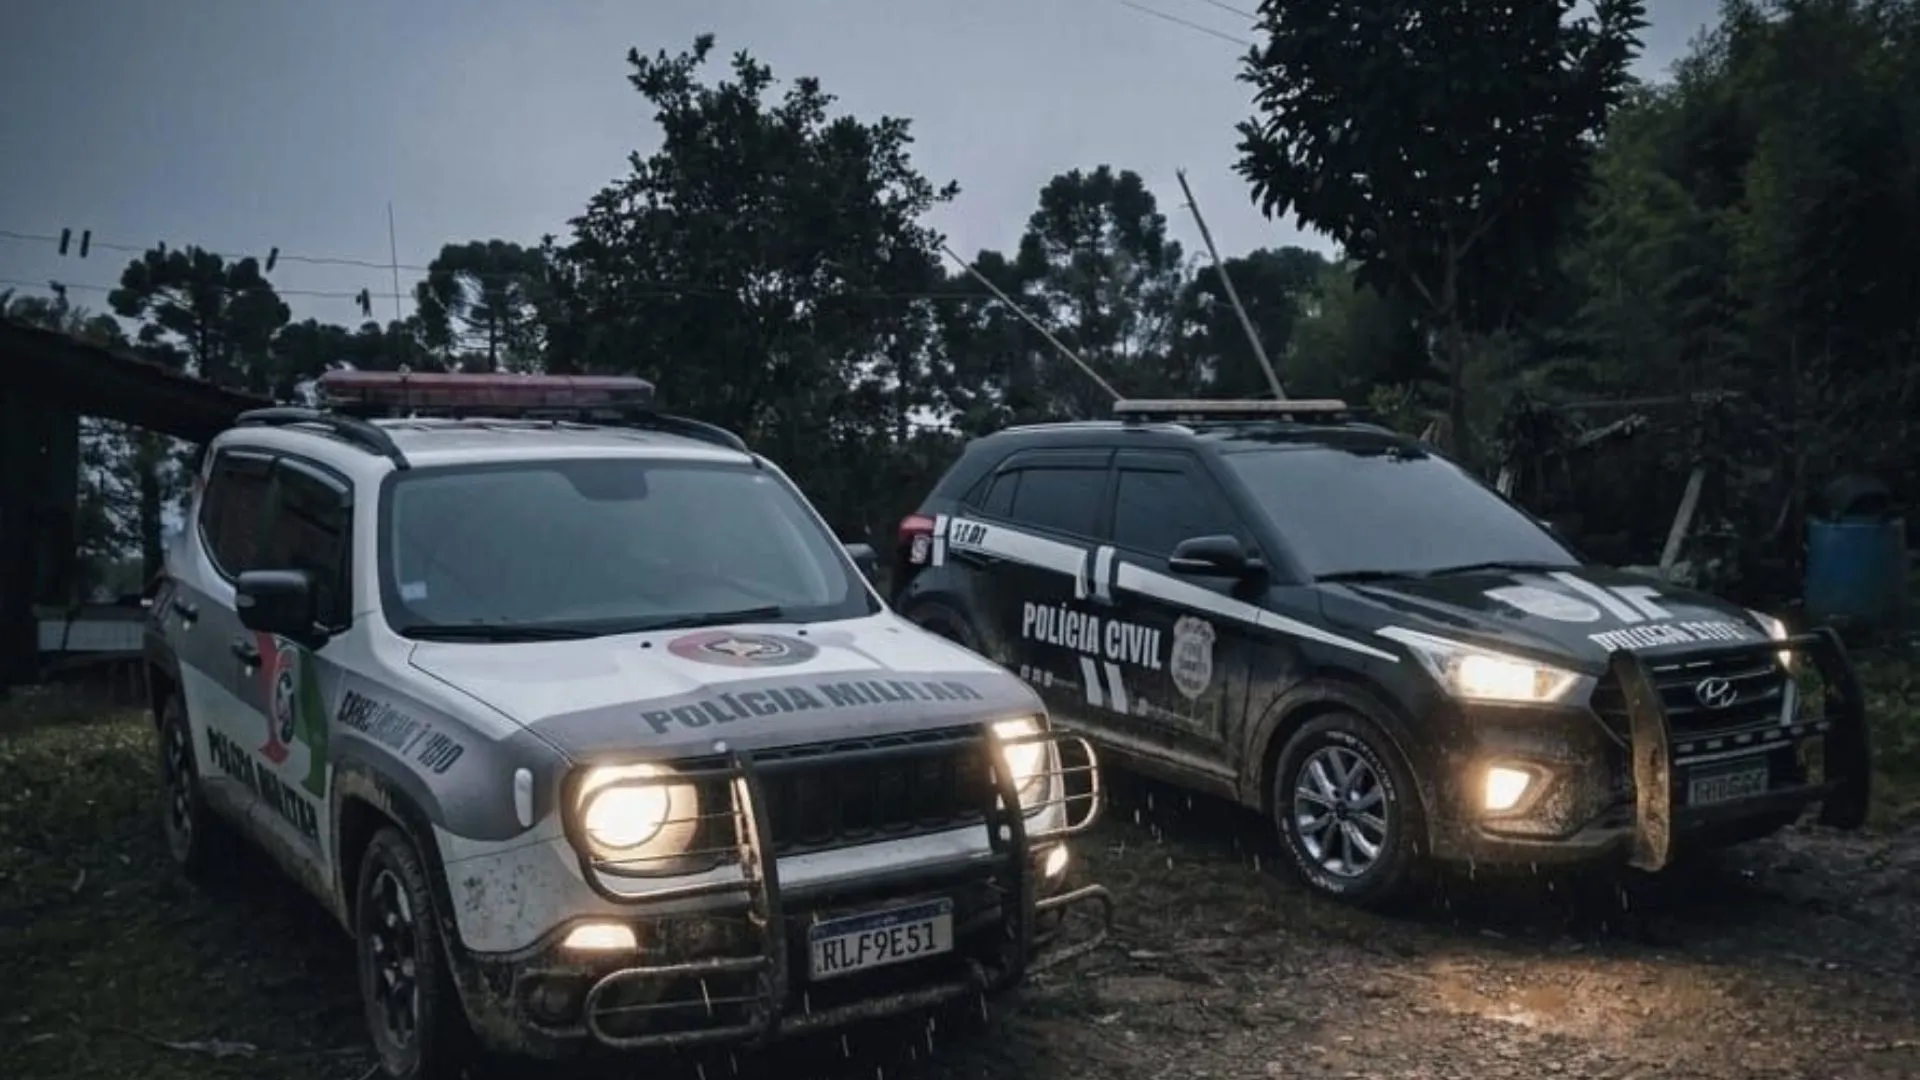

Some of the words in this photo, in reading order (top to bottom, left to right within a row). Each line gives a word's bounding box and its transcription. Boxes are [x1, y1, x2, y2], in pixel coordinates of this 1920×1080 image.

[1022, 602, 1099, 655] POLÍCIA
[1104, 620, 1162, 670] CIVIL
[640, 687, 824, 734] POLÍCIA
[822, 921, 937, 973] RLF9E51
